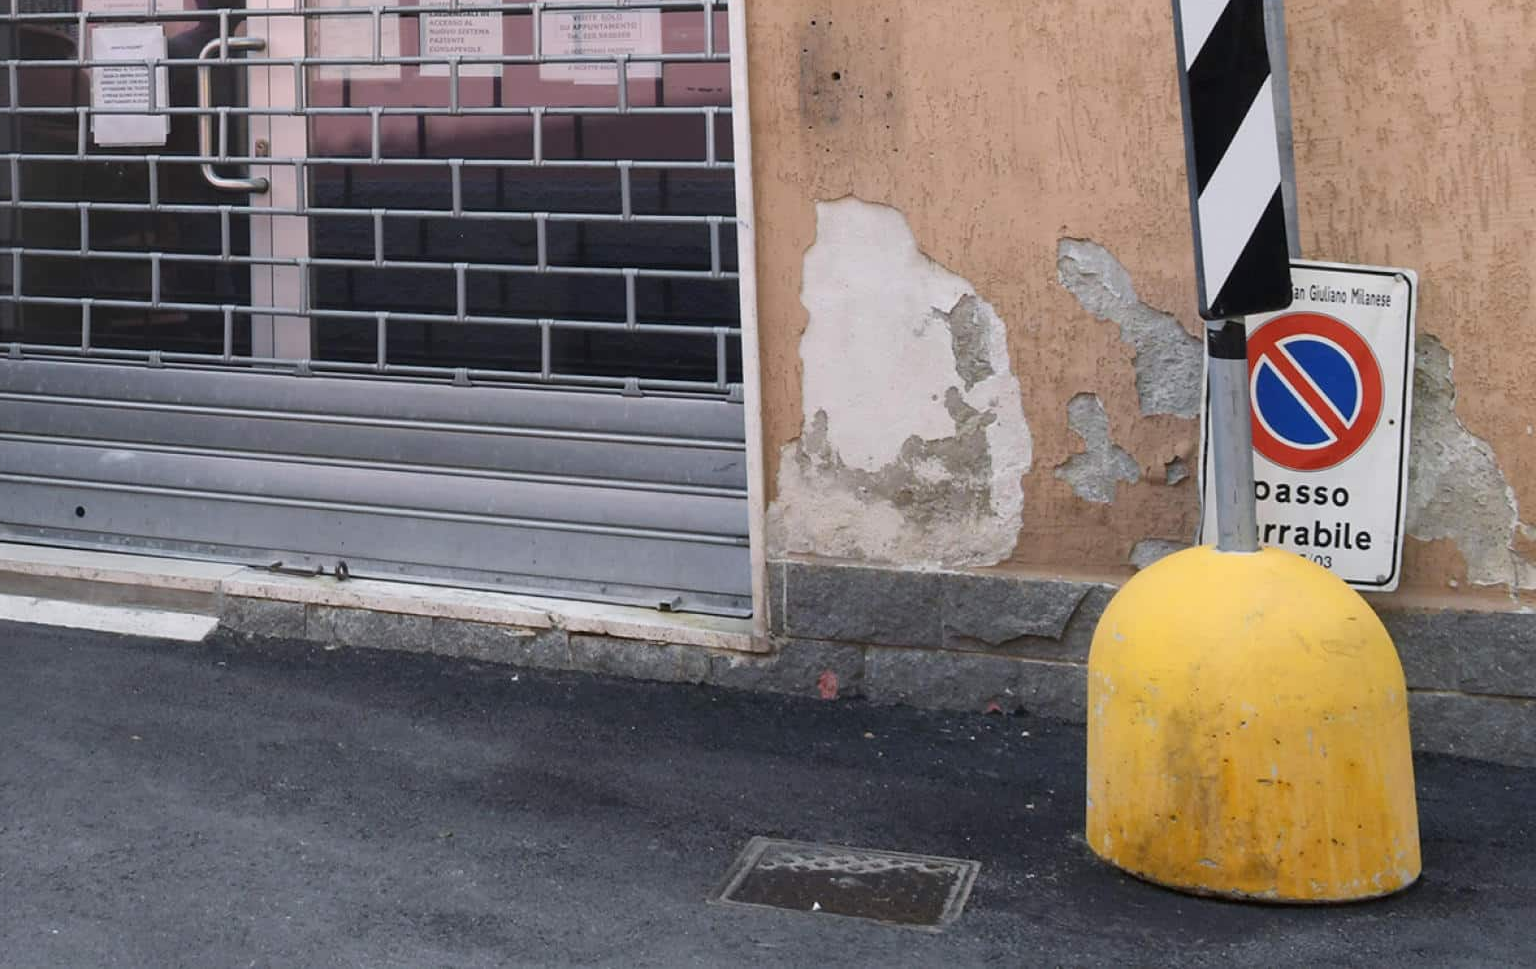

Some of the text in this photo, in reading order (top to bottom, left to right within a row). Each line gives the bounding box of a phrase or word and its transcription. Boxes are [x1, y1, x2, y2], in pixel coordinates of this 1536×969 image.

[572, 22, 638, 31] APPUNTAMENTO
[1292, 284, 1391, 308] an Giuliano Milanese
[1256, 520, 1372, 551] rrabile
